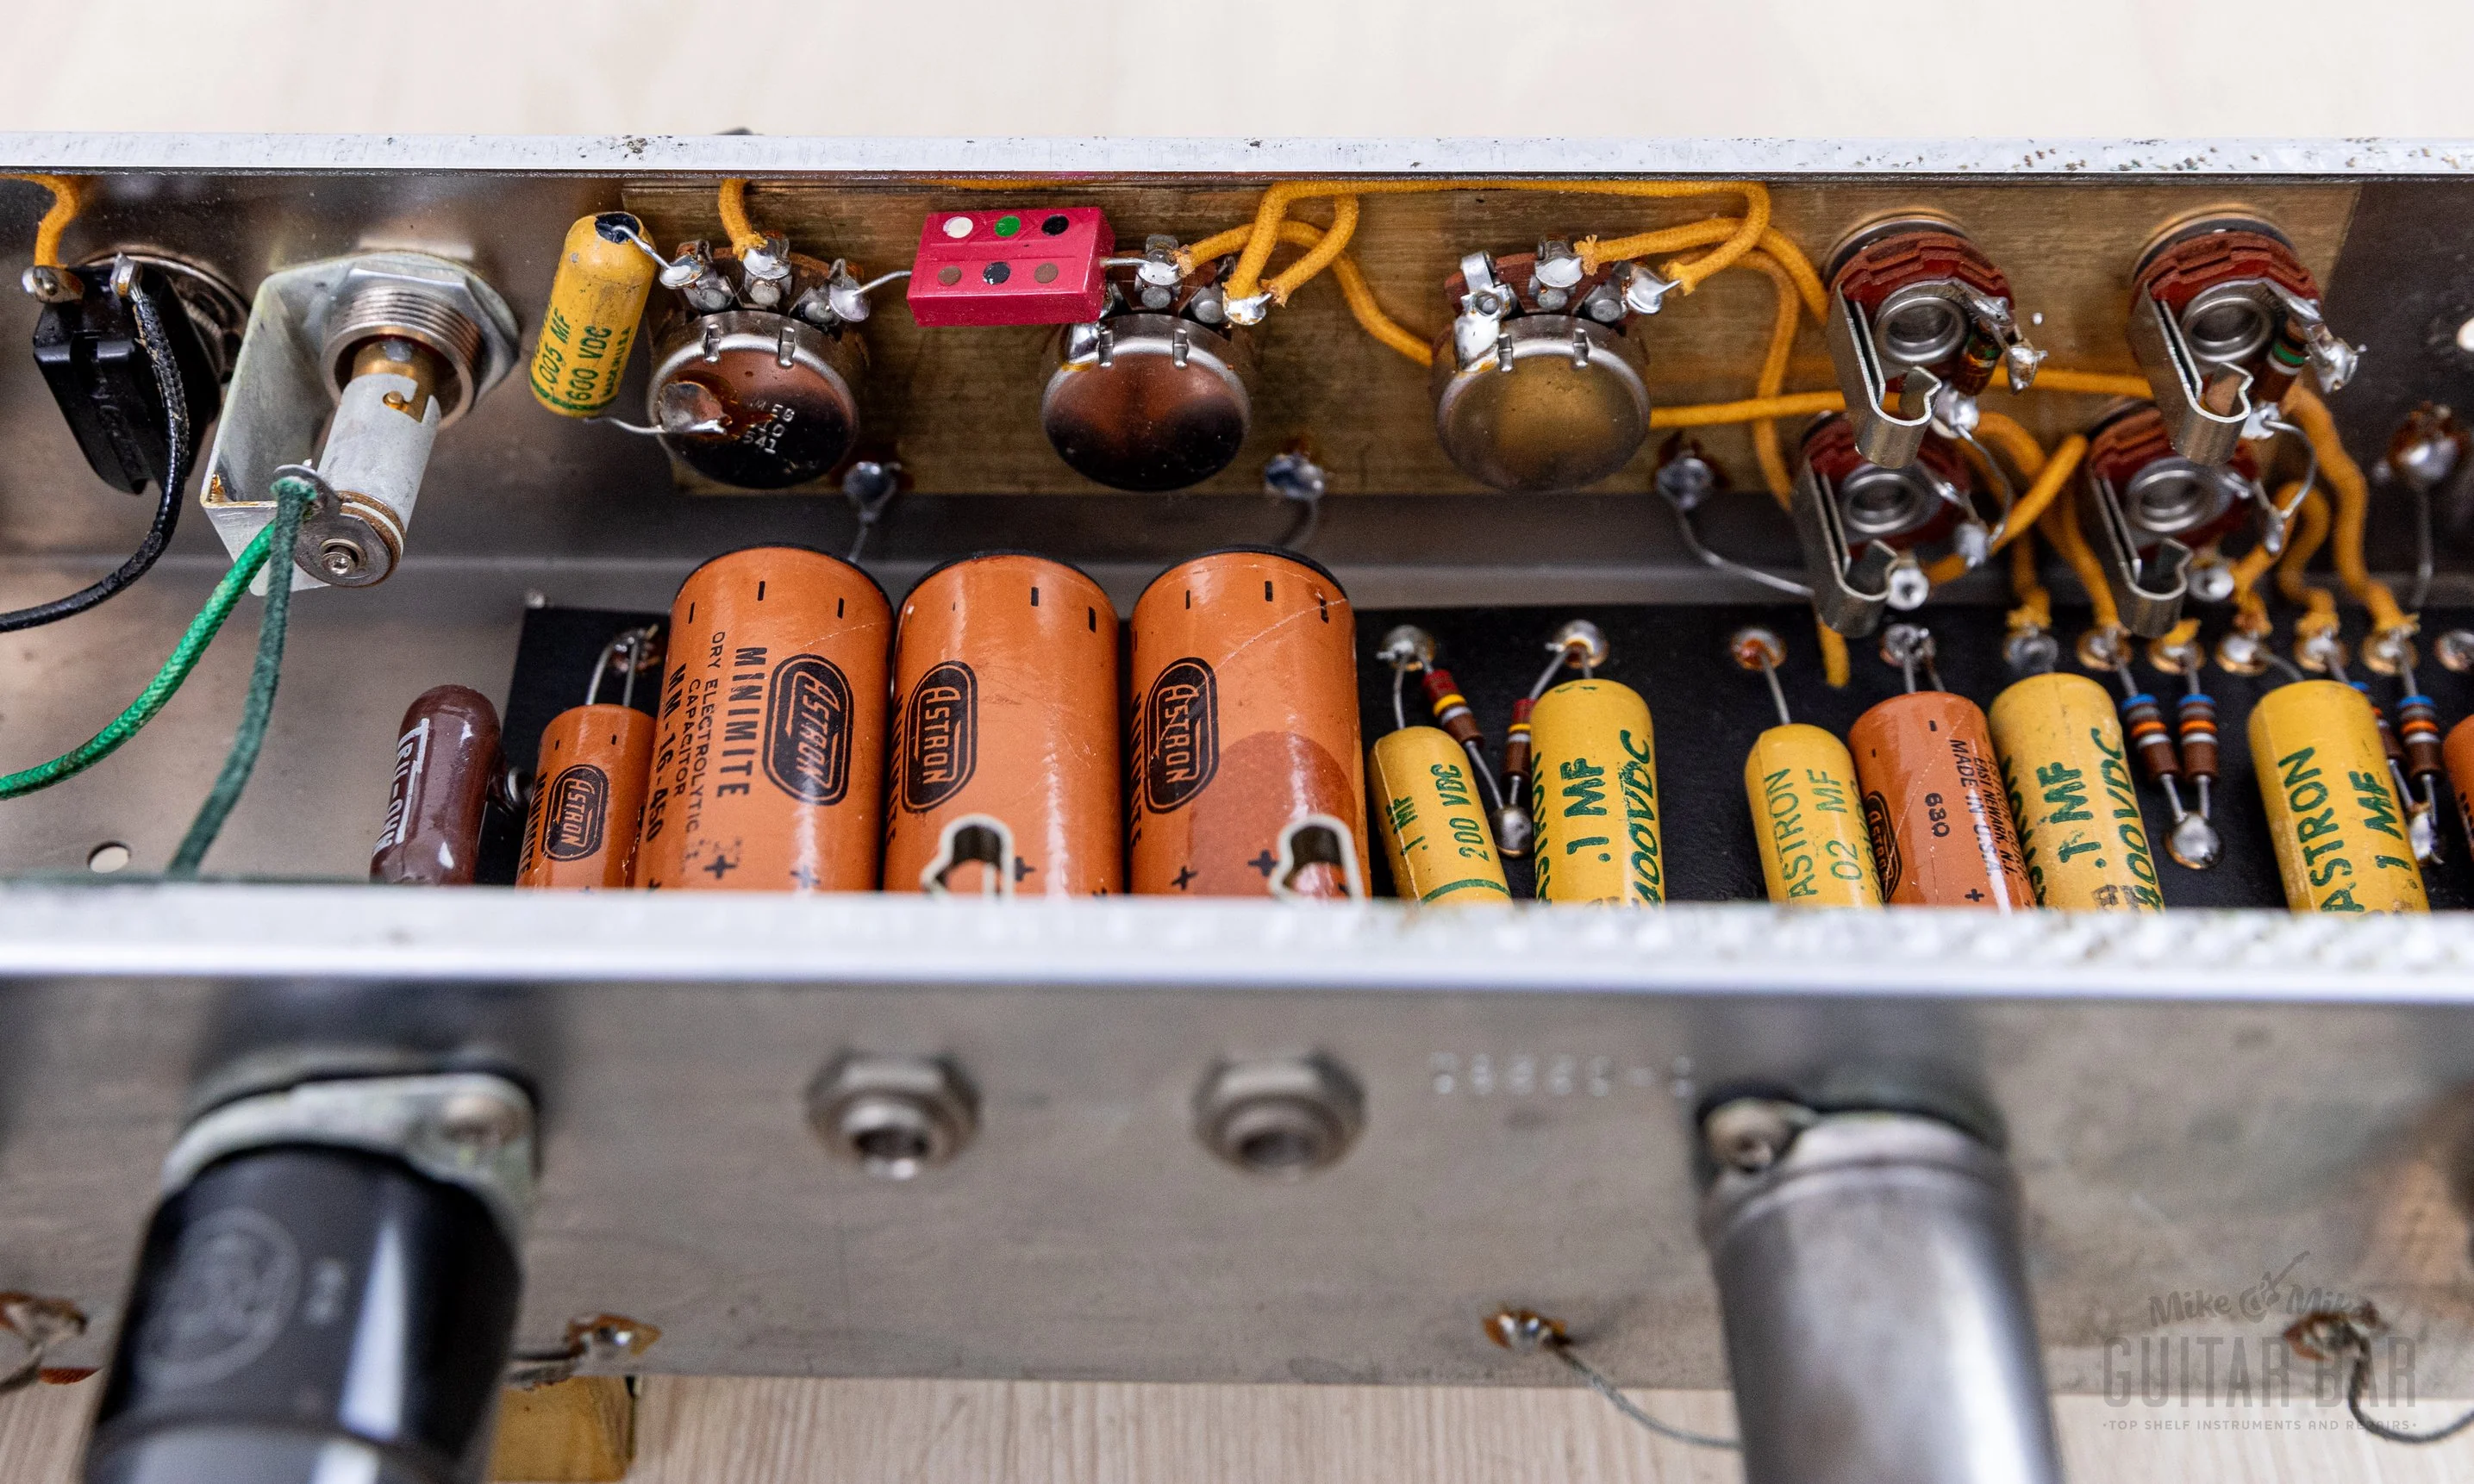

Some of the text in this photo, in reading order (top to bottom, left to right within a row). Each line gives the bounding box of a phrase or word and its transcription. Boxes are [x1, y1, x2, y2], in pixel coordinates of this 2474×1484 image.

[550, 308, 571, 345] MF
[565, 324, 612, 401] 600 VDC
[673, 679, 701, 797] CAPACITOR
[685, 631, 726, 834] DRY ELECTROLYTIC
[717, 647, 768, 797] MINIMITE
[914, 686, 962, 784] ASTRON
[1155, 683, 1201, 783] ASTRON
[1559, 758, 1607, 818] MF
[1807, 769, 1849, 814] MF
[1949, 739, 1980, 788] MADE
[1965, 795, 1987, 814] IN
[1974, 756, 1992, 788] EAST
[2036, 761, 2093, 825] MF
[2348, 770, 2403, 841] MF
[1385, 795, 1419, 834] MF
[1430, 764, 1490, 863] 200 VDC
[1764, 769, 1819, 898] ASTRON
[1924, 792, 1951, 838] 630
[2277, 746, 2365, 912] ASTRON
